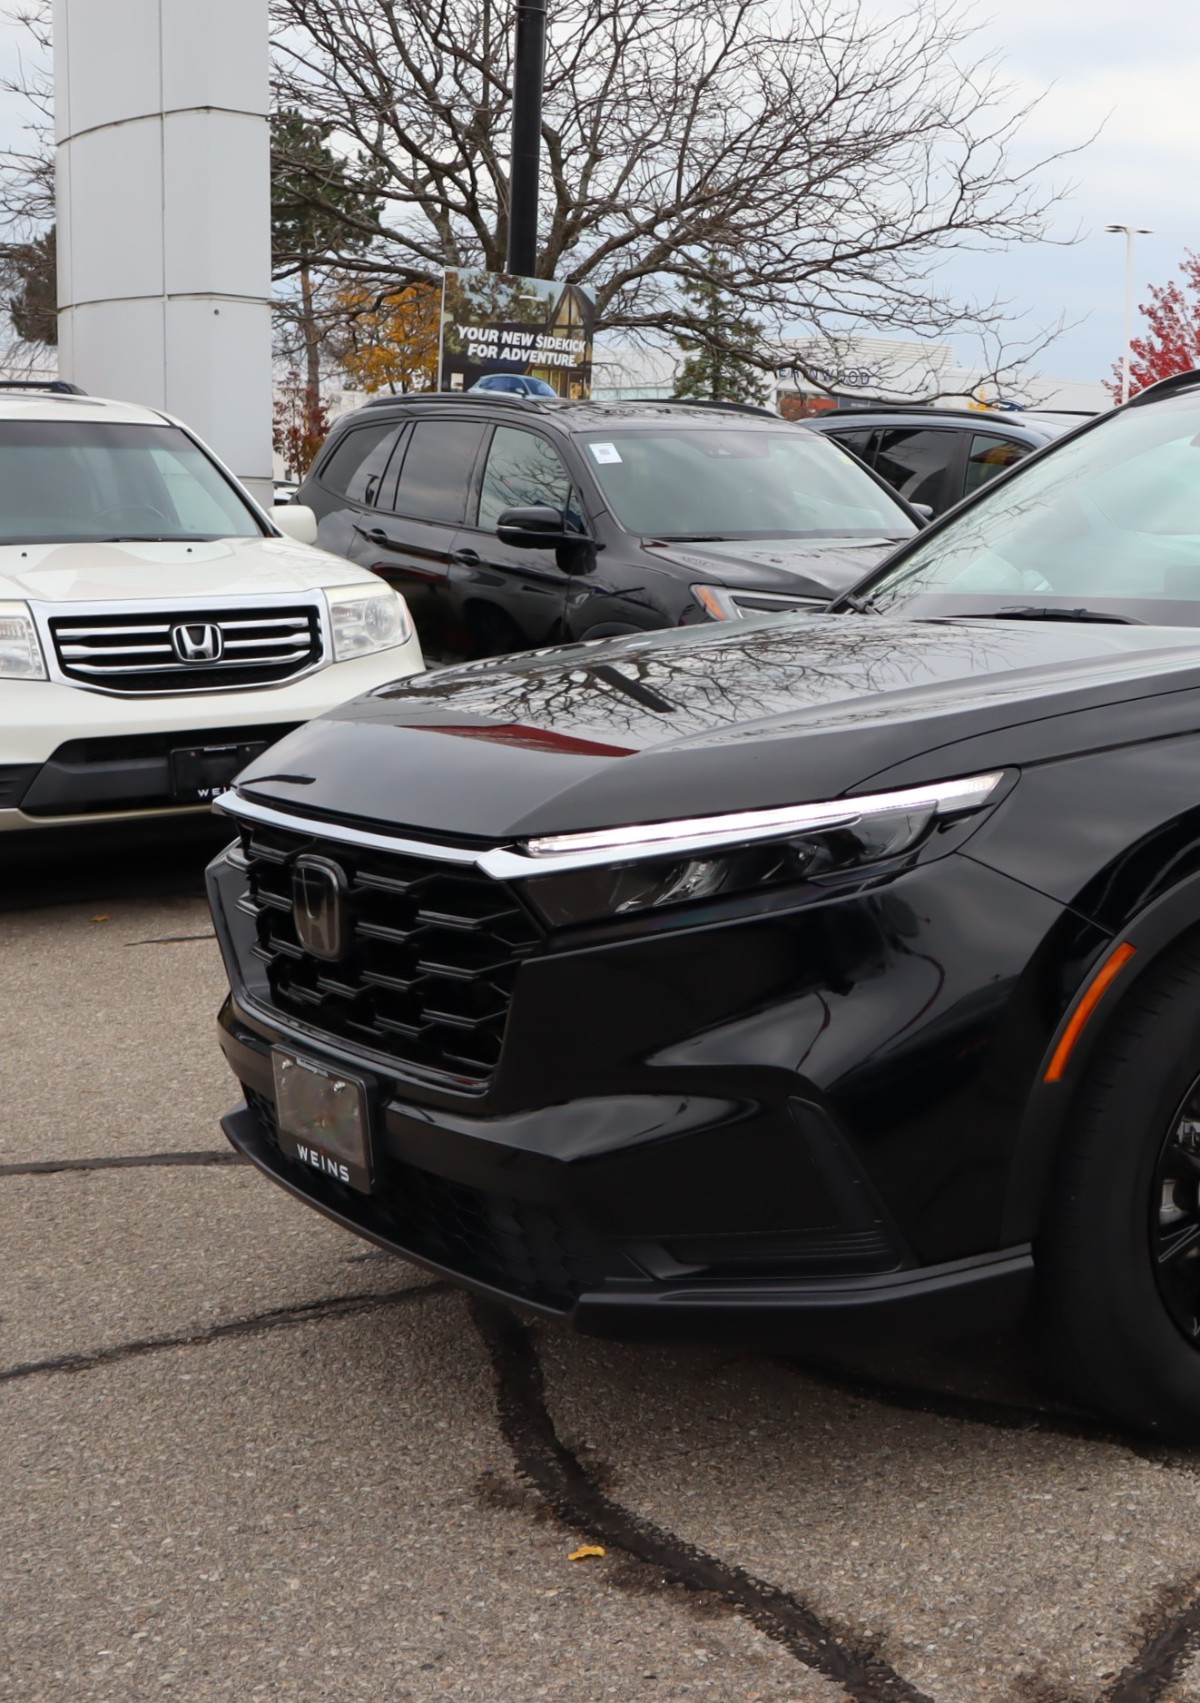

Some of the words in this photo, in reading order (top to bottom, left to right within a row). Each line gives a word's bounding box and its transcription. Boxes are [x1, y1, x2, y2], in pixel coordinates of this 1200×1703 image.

[457, 324, 499, 343] YOUR
[501, 330, 535, 347] NEW
[536, 334, 586, 353] SIDEKICK
[467, 343, 498, 359] FOR
[500, 348, 577, 367] ADVENTURE.
[297, 1143, 350, 1182] WEINS
